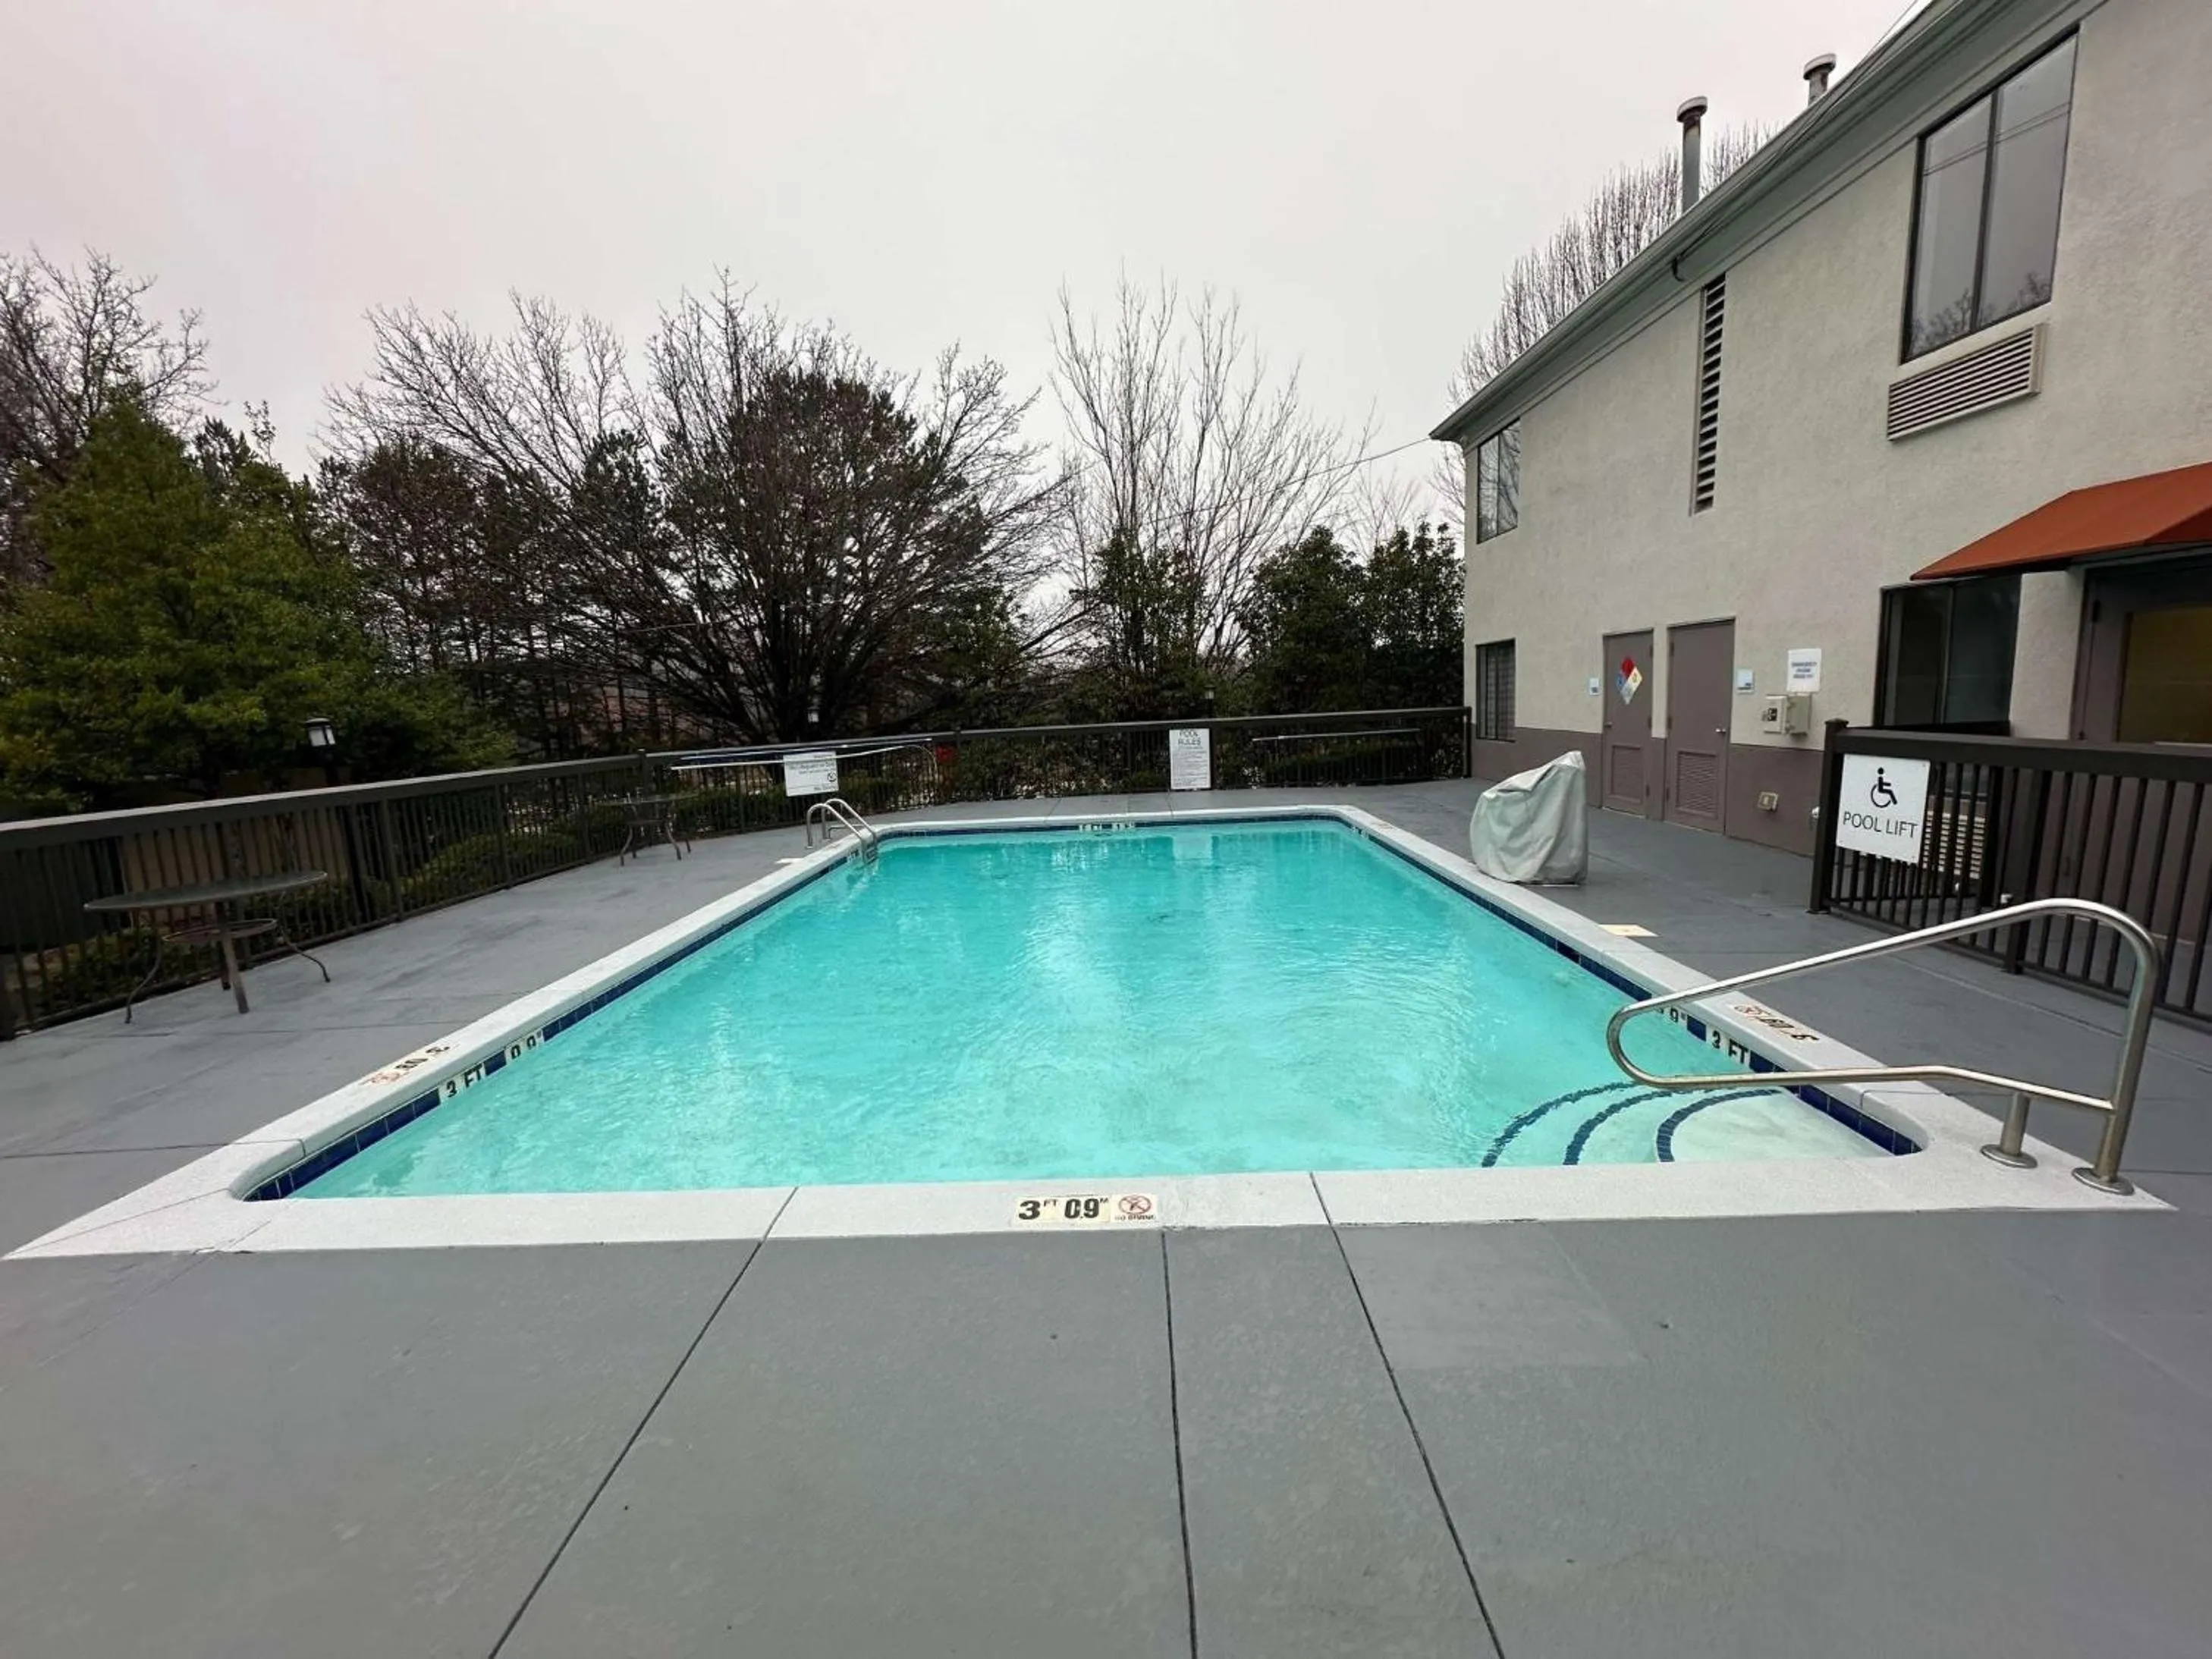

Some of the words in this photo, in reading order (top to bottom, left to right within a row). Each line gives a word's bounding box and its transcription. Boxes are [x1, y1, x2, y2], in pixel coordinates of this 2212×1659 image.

[1843, 811, 1882, 832] POOL
[1886, 819, 1918, 838] LIFT
[1712, 1030, 1720, 1049] 3
[1728, 1038, 1749, 1064] FT
[463, 1063, 482, 1088] FT
